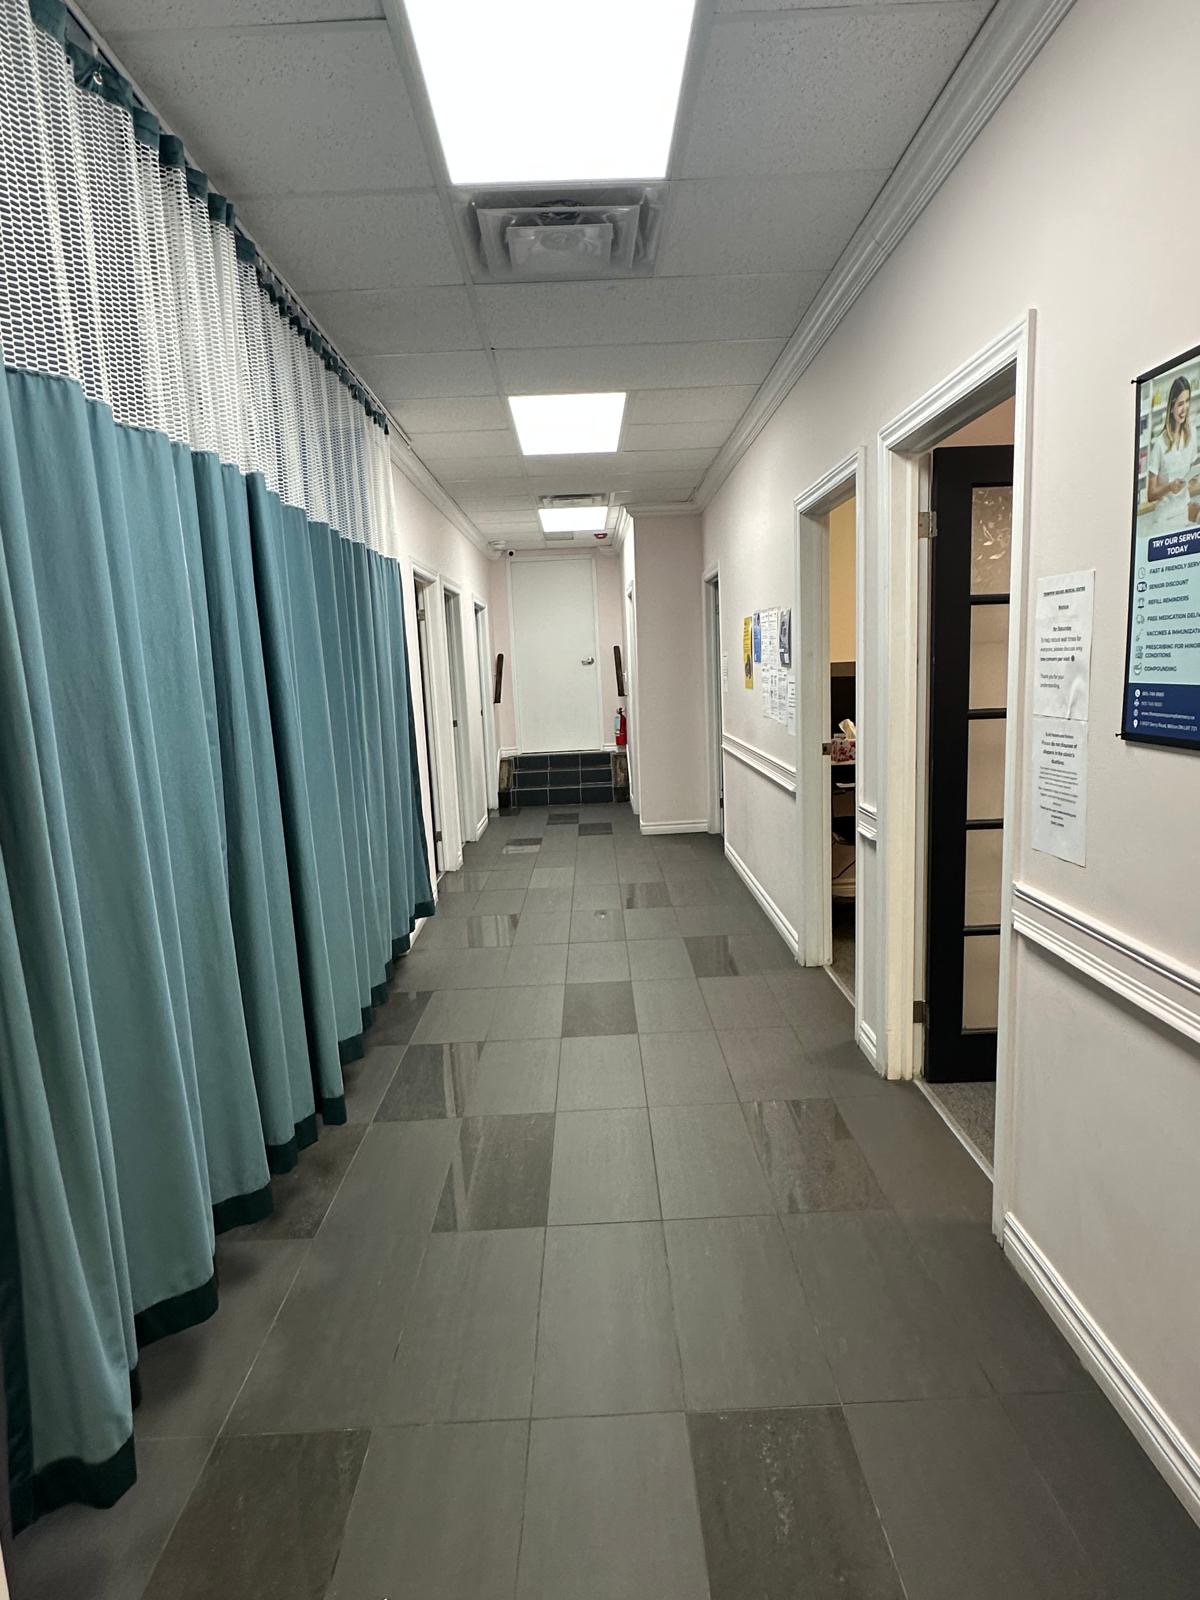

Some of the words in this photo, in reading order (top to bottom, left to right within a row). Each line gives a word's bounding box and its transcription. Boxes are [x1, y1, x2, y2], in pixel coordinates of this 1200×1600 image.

[1152, 539, 1165, 548] TRY
[1164, 536, 1178, 546] OUR
[1167, 544, 1189, 555] TODAY
[1165, 563, 1187, 572] FRIENDLY
[1149, 582, 1165, 590] SENIOR
[1166, 579, 1189, 588] DISCOUNT
[1163, 595, 1189, 603] REMINDERS
[1159, 613, 1186, 621] MEDICATION
